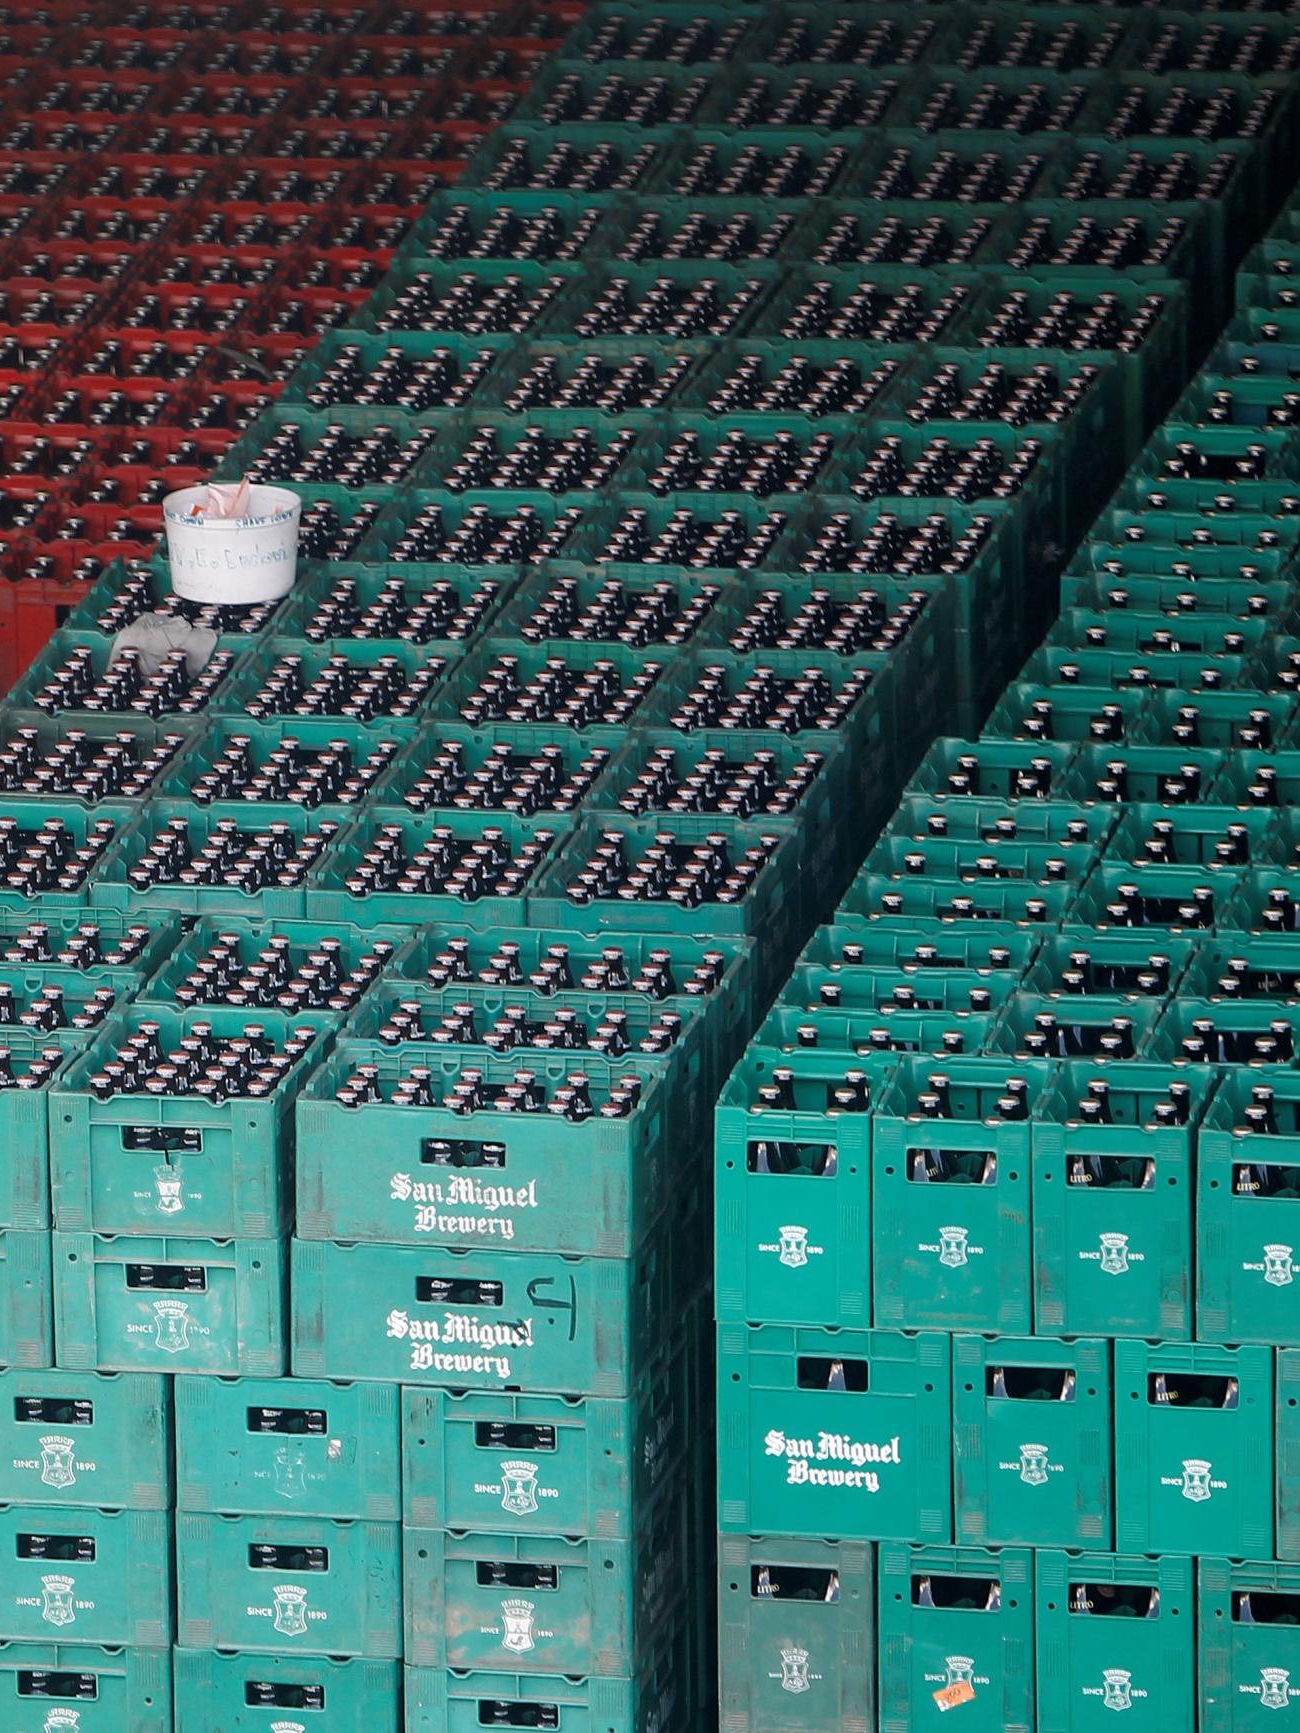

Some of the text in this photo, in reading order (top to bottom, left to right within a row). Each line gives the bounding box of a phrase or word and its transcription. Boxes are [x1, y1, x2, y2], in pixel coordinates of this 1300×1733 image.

[390, 1172, 538, 1211] San Miguel
[413, 1204, 514, 1240] Brewery
[759, 1244, 824, 1254] SINCE 1890
[919, 1243, 984, 1254] SINCE 1890
[1079, 1251, 1145, 1261] SINCE 1890
[1242, 1262, 1265, 1271] SINCE
[127, 1324, 154, 1334] SINCE
[386, 1309, 534, 1350] San Miguel
[410, 1342, 511, 1379] Brewery
[764, 1429, 901, 1467] San Miguel
[12, 1459, 96, 1471] SINCE 1890
[999, 1462, 1020, 1470] SINCE
[787, 1458, 880, 1493] Brewery
[1161, 1477, 1228, 1489] SINCE 1890
[474, 1484, 559, 1498] SINCE 1890
[16, 1597, 95, 1609] SINCE 1890
[247, 1606, 327, 1620] SINCE 1890
[924, 1673, 990, 1685] SINCE 1890
[1082, 1687, 1148, 1698] SINCE 1890
[1239, 1685, 1261, 1694] SINCE
